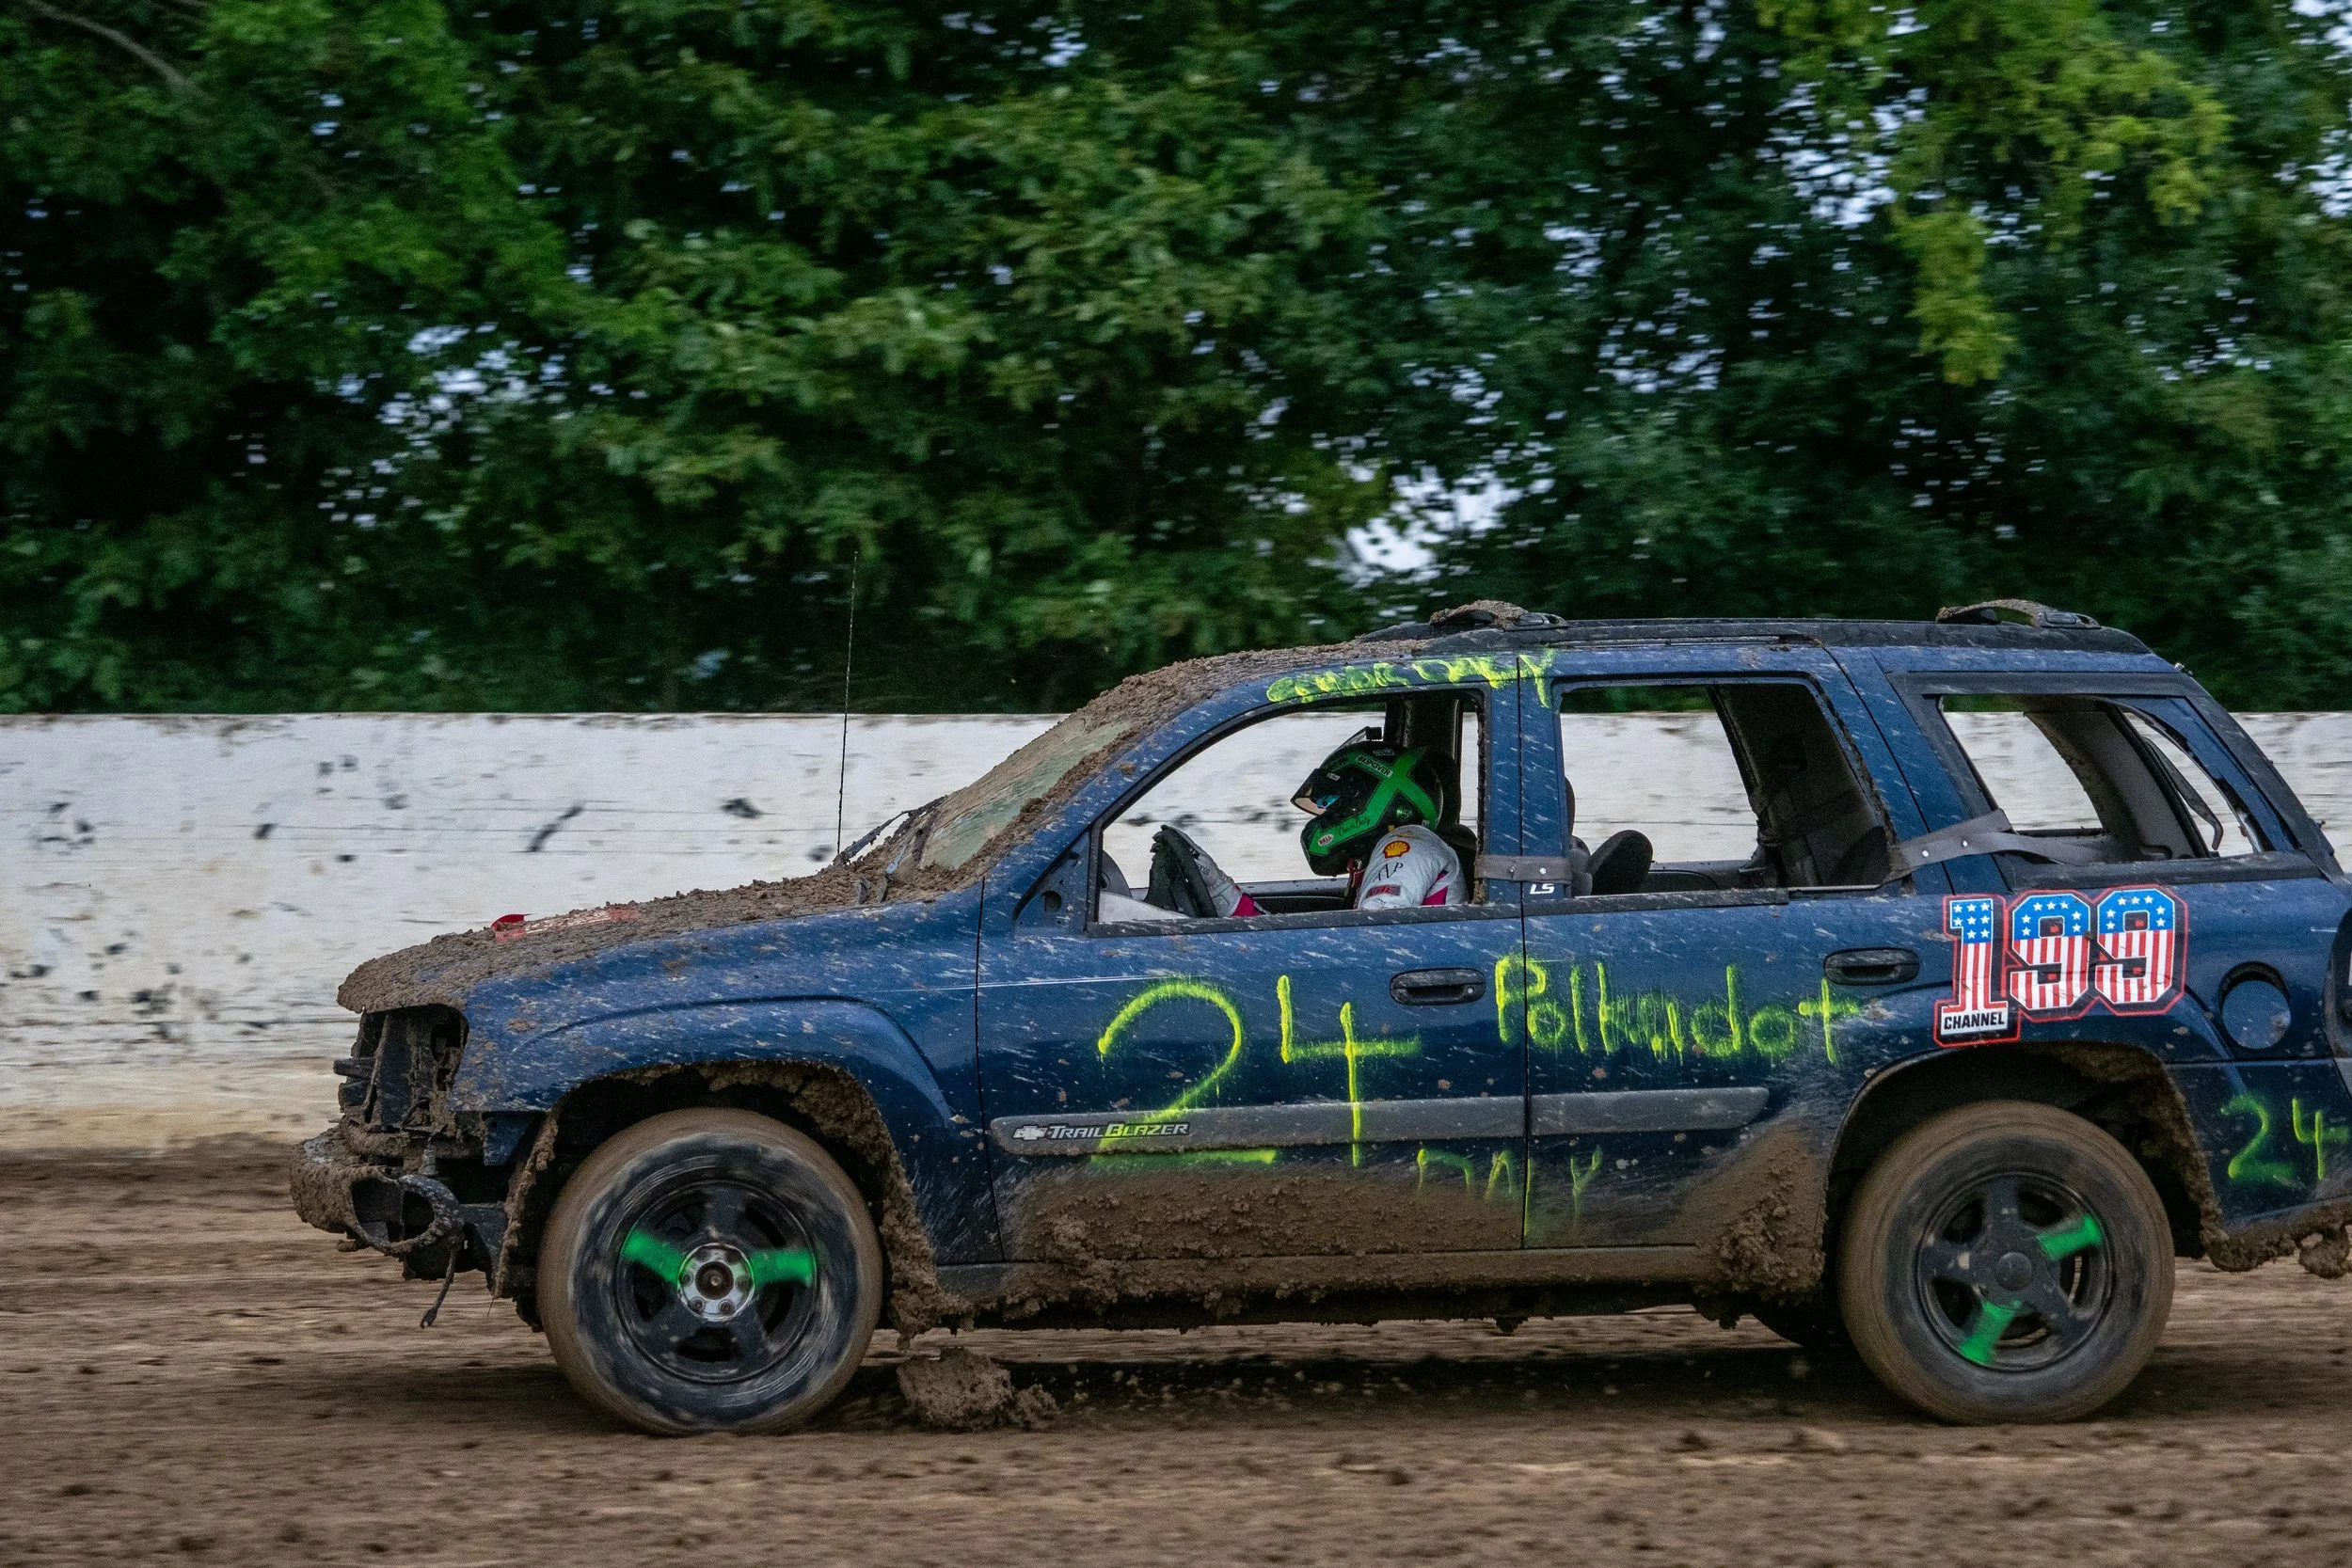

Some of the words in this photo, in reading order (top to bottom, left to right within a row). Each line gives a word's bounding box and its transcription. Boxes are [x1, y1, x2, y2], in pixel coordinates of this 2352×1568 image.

[1319, 835, 1332, 845] BELL
[1529, 883, 1555, 895] LS
[1941, 888, 2176, 1013] 199
[1944, 1012, 2005, 1030] CHANNEL
[1091, 974, 1420, 1168] 24
[2220, 1092, 2350, 1180] 24
